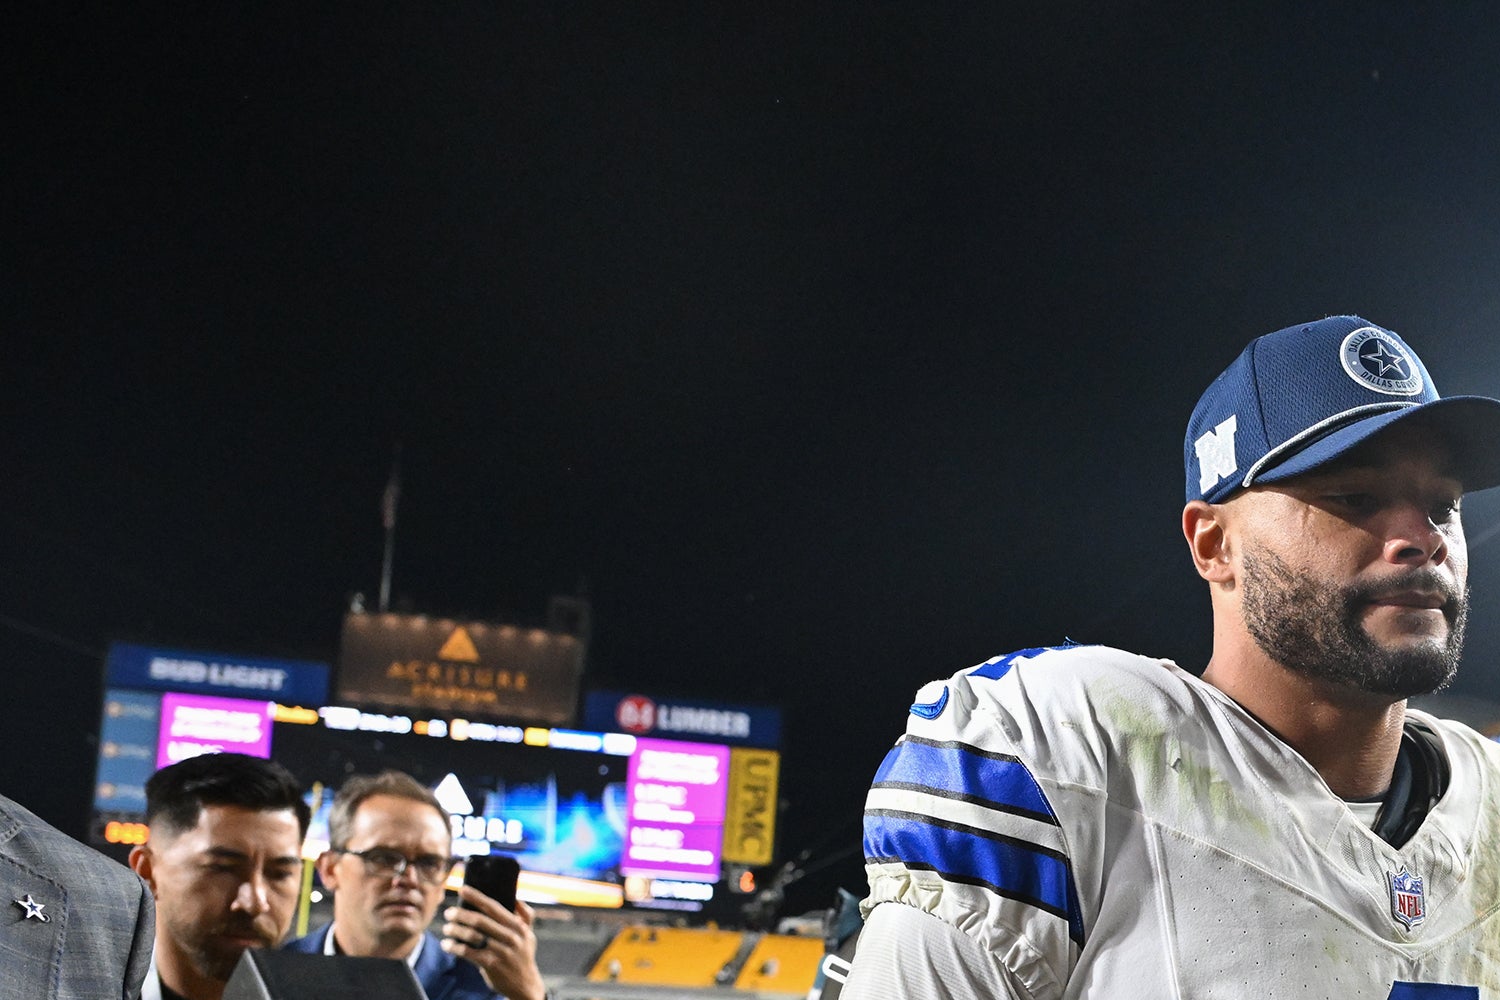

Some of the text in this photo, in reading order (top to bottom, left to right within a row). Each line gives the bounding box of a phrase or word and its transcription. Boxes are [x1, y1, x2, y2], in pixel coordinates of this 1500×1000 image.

[1348, 332, 1370, 353] DALLAS
[1360, 371, 1393, 388] DALLAS
[207, 662, 288, 692] LIGHT
[656, 704, 750, 738] LUMBER
[741, 757, 771, 860] UPMC
[449, 814, 523, 844] SURE
[1397, 893, 1421, 918] NFL
